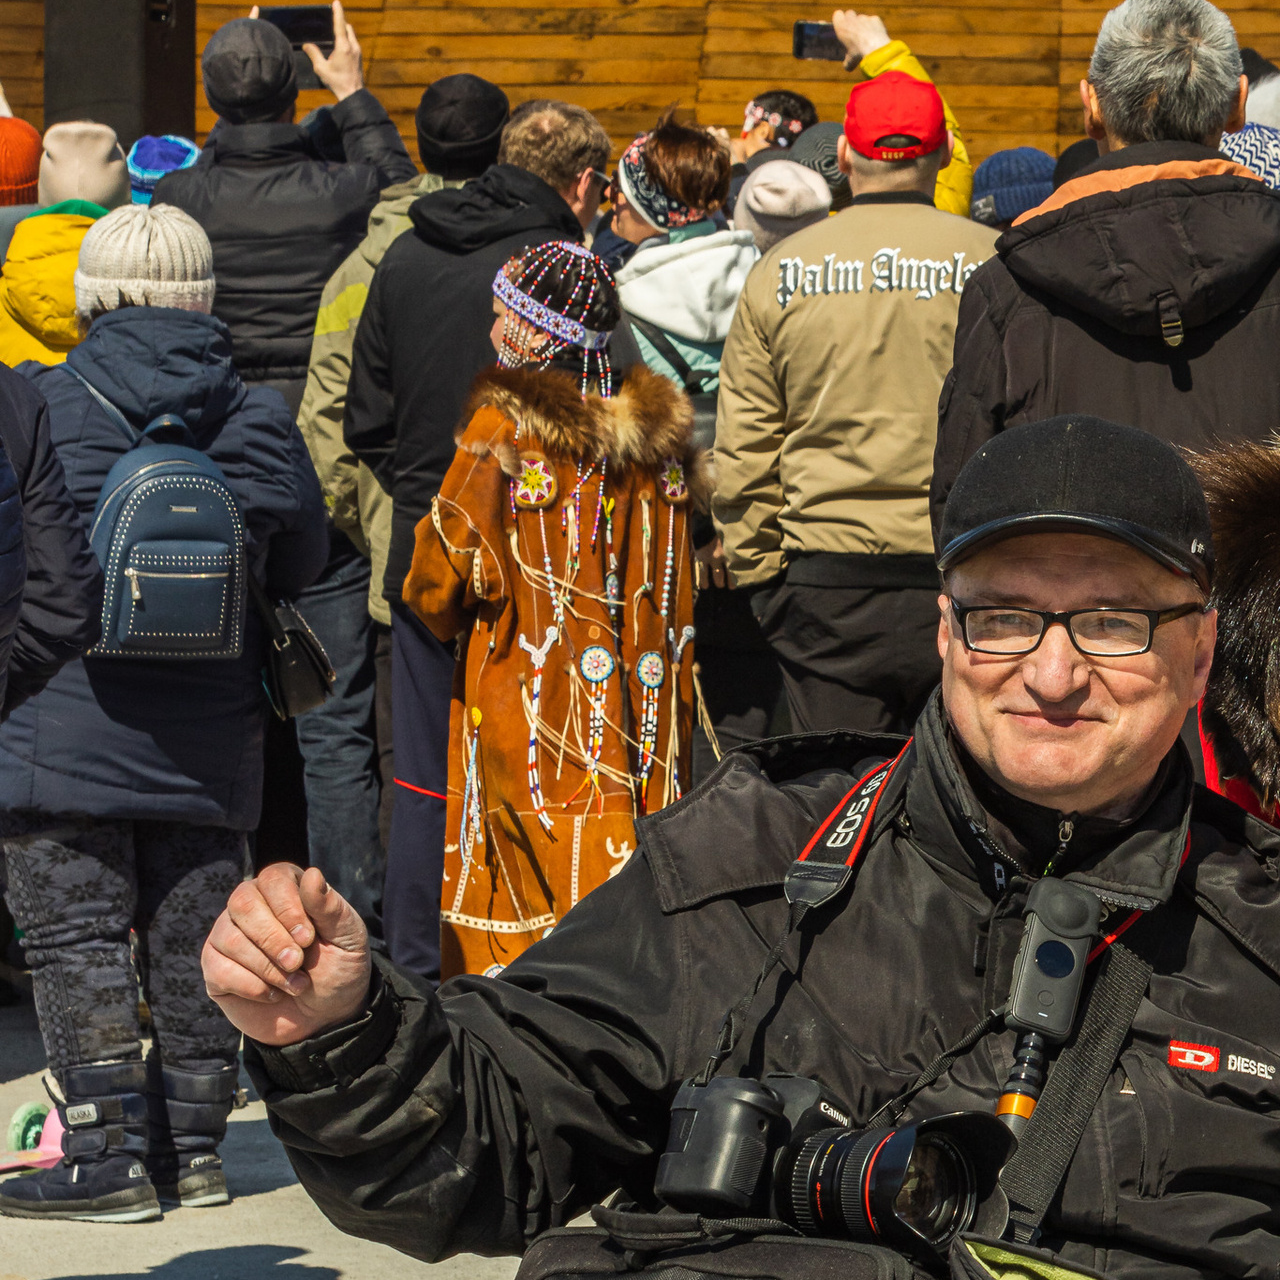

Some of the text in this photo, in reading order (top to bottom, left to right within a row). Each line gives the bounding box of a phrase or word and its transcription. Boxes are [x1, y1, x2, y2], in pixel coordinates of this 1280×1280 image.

[776, 253, 864, 310] Palm
[826, 797, 870, 847] EOS
[820, 1101, 849, 1127] Canon
